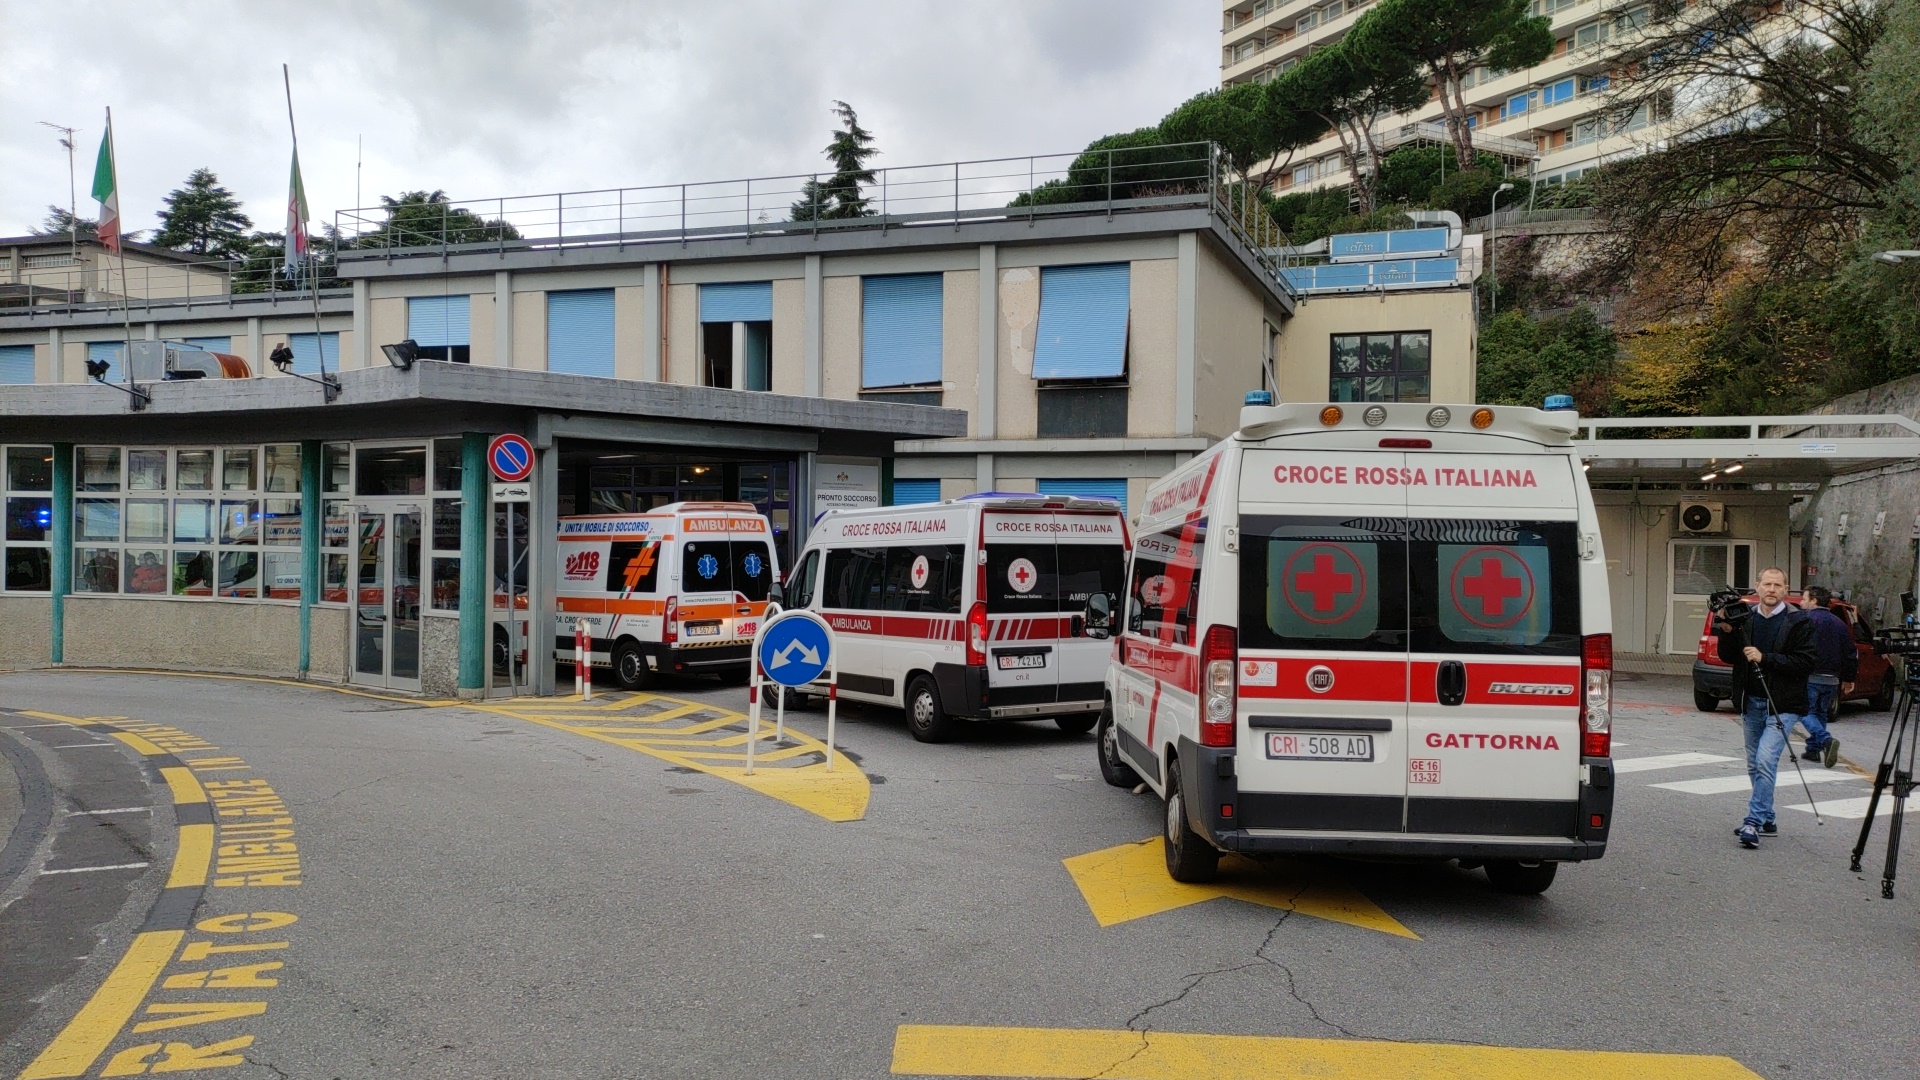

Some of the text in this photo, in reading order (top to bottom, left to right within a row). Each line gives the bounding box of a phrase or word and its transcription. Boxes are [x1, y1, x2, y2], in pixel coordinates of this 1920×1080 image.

[1274, 465, 1537, 488] CROCE ROSSA ITALIANA
[565, 522, 649, 532] UNITA' MOBILE DI SOCCORSO
[689, 520, 762, 531] AMBULANZA
[842, 519, 946, 536] CROCE ROSSA ITALIANA
[996, 522, 1113, 533] CROCE ROSSA ITALIANA
[578, 551, 600, 570] 118
[744, 622, 757, 631] 118
[831, 618, 871, 630] AMBULANZA
[1033, 657, 1042, 666] AG
[1314, 674, 1328, 684] FIAT
[1489, 683, 1573, 694] DUCATO
[1272, 736, 1366, 756] CRI 508 AD
[1426, 733, 1560, 750] GATTORNA
[186, 756, 251, 771] IN
[1411, 760, 1438, 771] GE 16
[1413, 773, 1438, 782] 13-32
[204, 779, 302, 888] AMBULANZE
